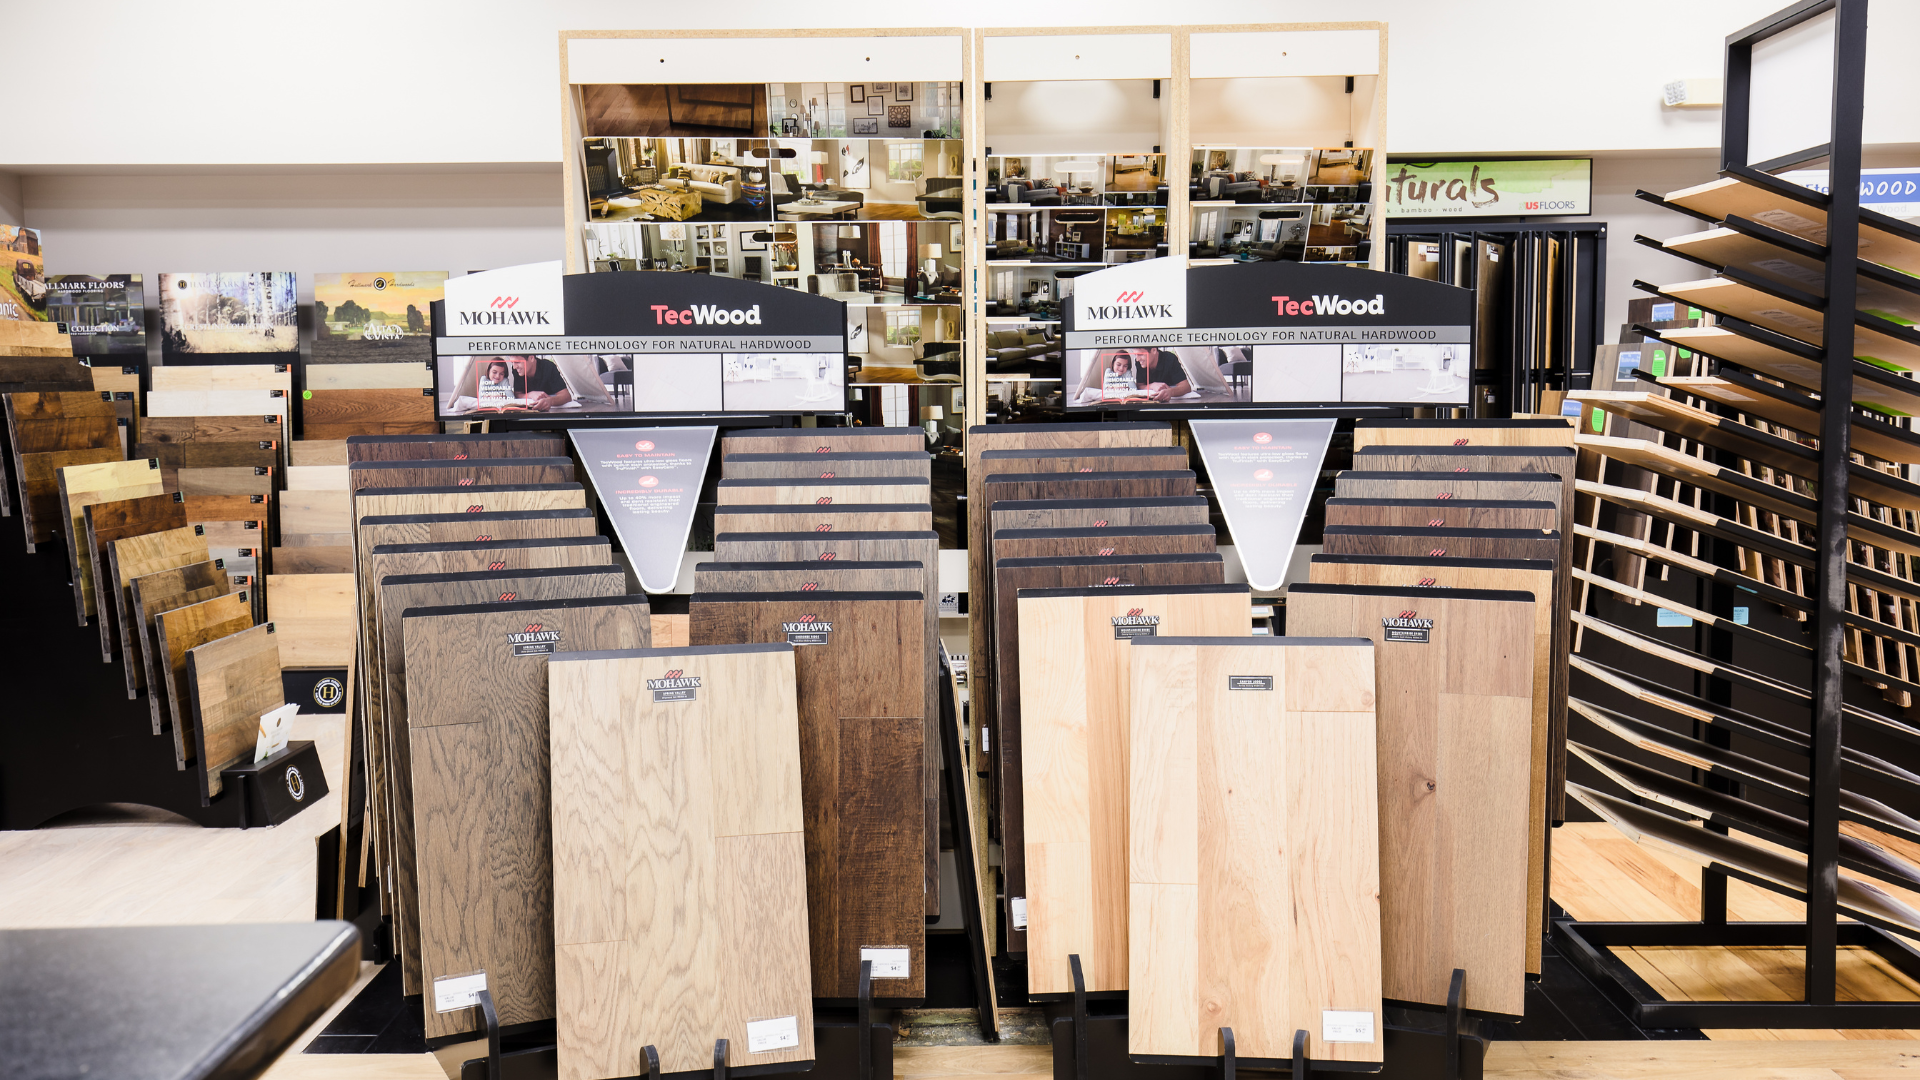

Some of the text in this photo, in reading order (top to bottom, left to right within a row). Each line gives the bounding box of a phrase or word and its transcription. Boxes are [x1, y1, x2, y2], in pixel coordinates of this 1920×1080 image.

[1860, 180, 1917, 196] WOOD
[88, 281, 124, 289] FLOORS
[1272, 294, 1384, 316] TecWood
[460, 311, 550, 325] MOHAWK
[650, 305, 762, 325] TecWood
[1088, 304, 1173, 320] MOHAWK
[1095, 330, 1436, 344] PERFORMANCE TECHNOLOGY FOR NATURAL HARDWOOD
[468, 340, 812, 351] PERFORMANCE TECHNOLOGY FOR NATURAL HARDWOOD
[1111, 616, 1160, 625] MOHAWK
[1382, 617, 1433, 628] MOHAWK
[783, 622, 832, 632] MOHAWK
[508, 631, 560, 643] MOHAWK
[648, 677, 700, 689] MOHAWK
[322, 686, 334, 698] H
[290, 775, 300, 792] H
